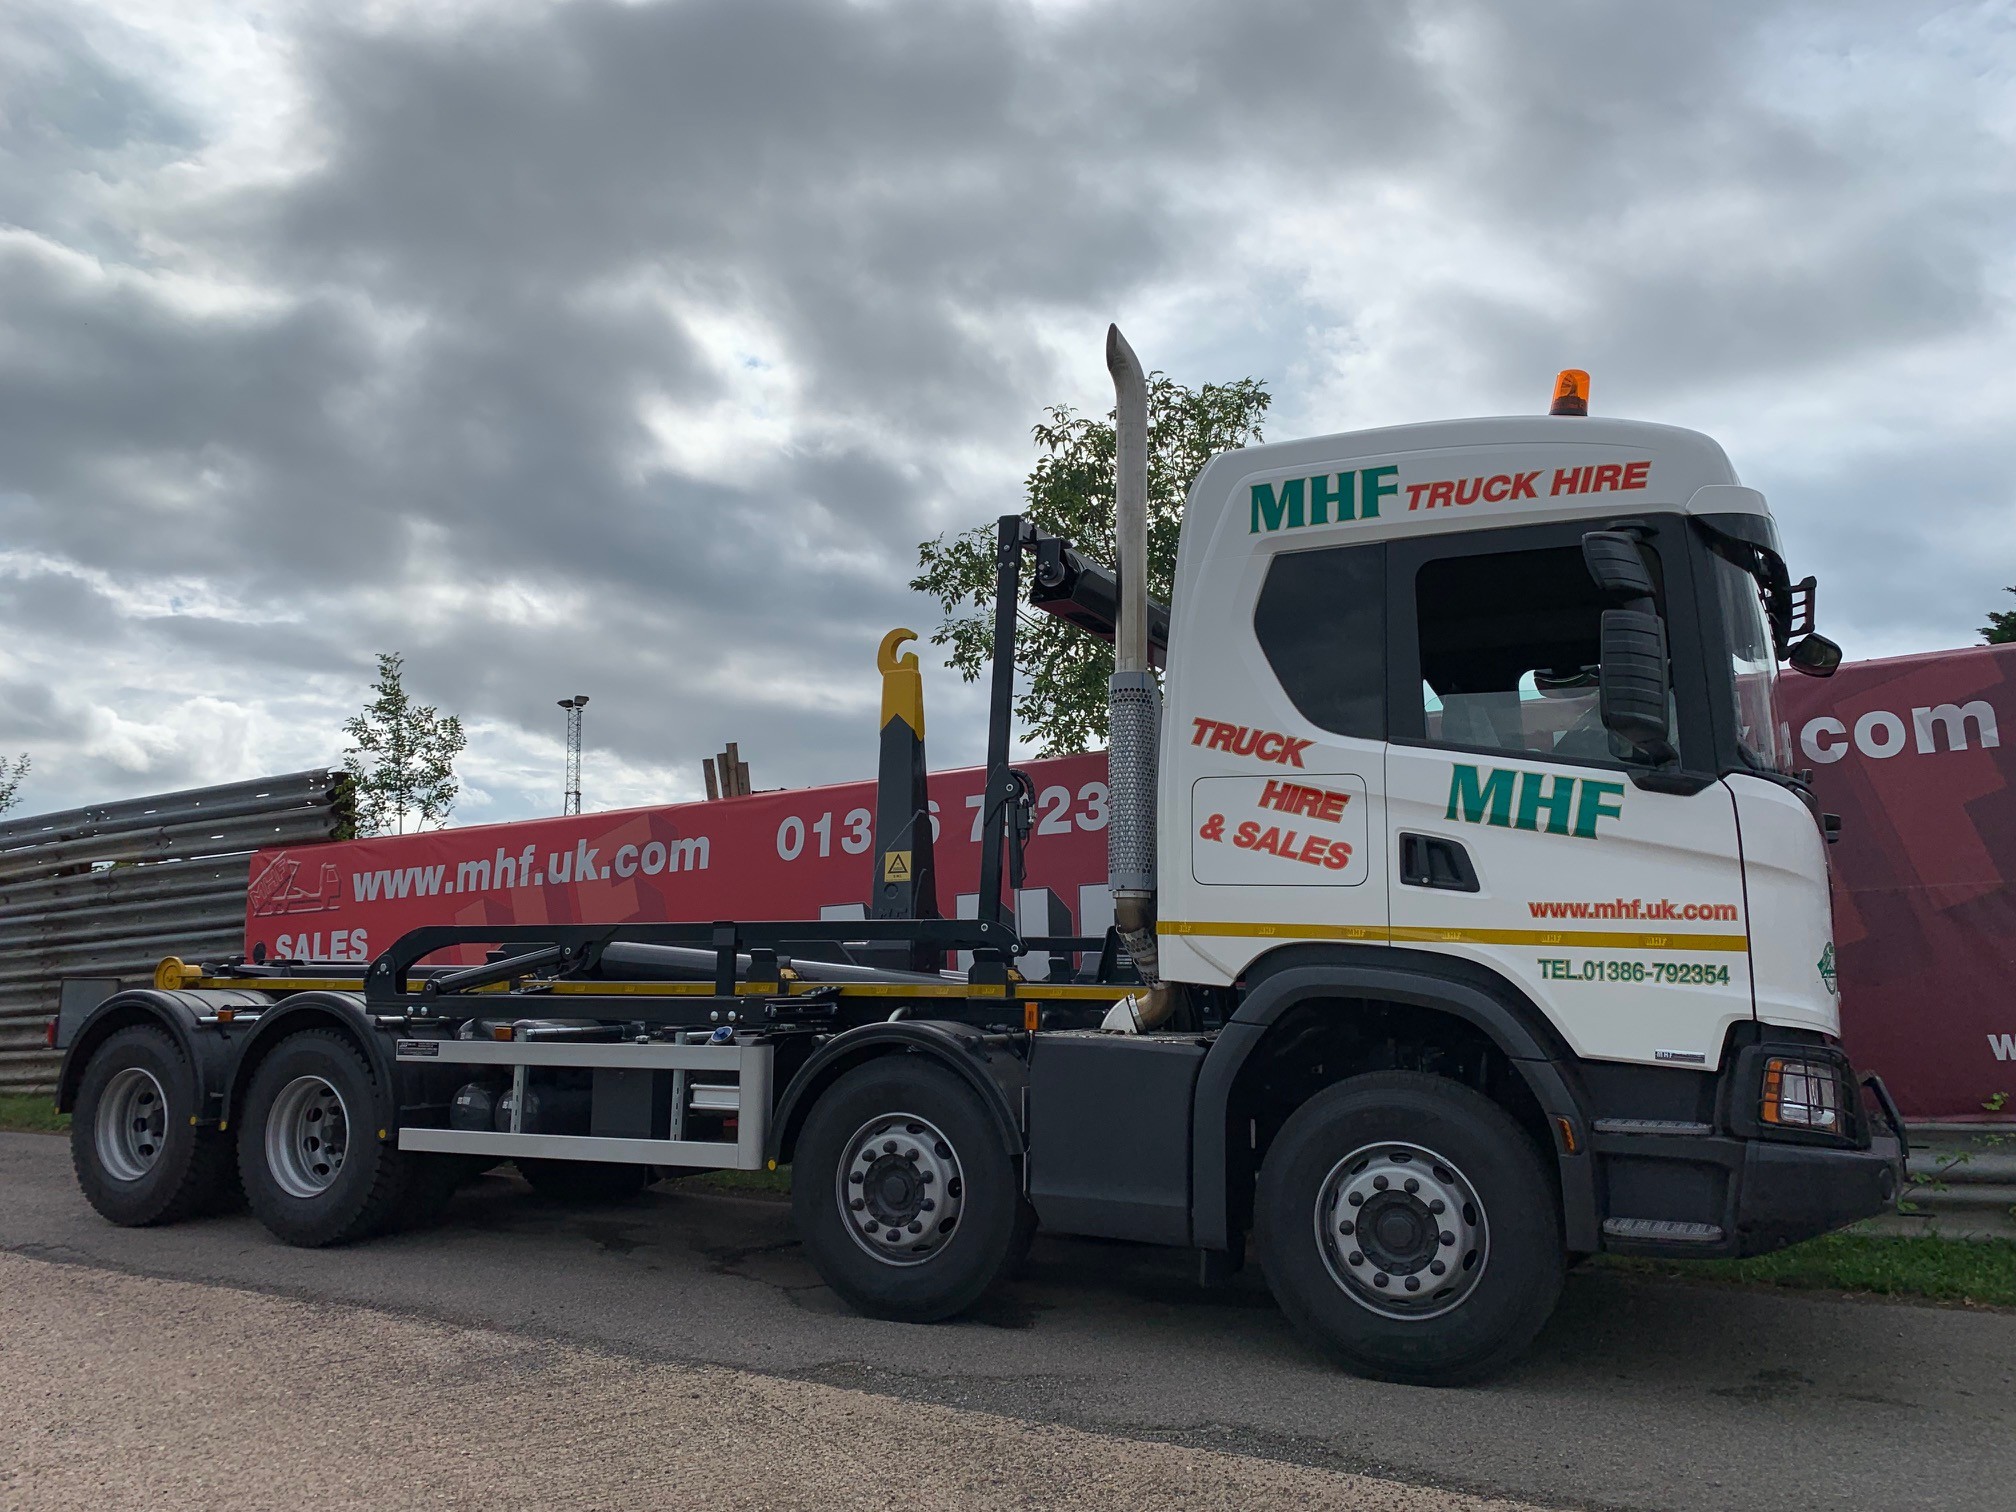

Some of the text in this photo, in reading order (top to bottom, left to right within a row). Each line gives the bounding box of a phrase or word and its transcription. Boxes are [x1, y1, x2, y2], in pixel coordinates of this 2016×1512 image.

[1250, 461, 1652, 534] MHF TRUCK HIRE
[1192, 717, 1314, 769] TRUCK
[1257, 780, 1351, 824] HIRE
[1444, 763, 1624, 840] MHF
[1199, 813, 1353, 870] & SALES
[352, 835, 711, 902] www.mhf.uk.com
[1528, 898, 1738, 922] www.mhf.uk.com
[274, 928, 368, 960] SALES
[1537, 957, 1731, 987] TEL.01386-792354
